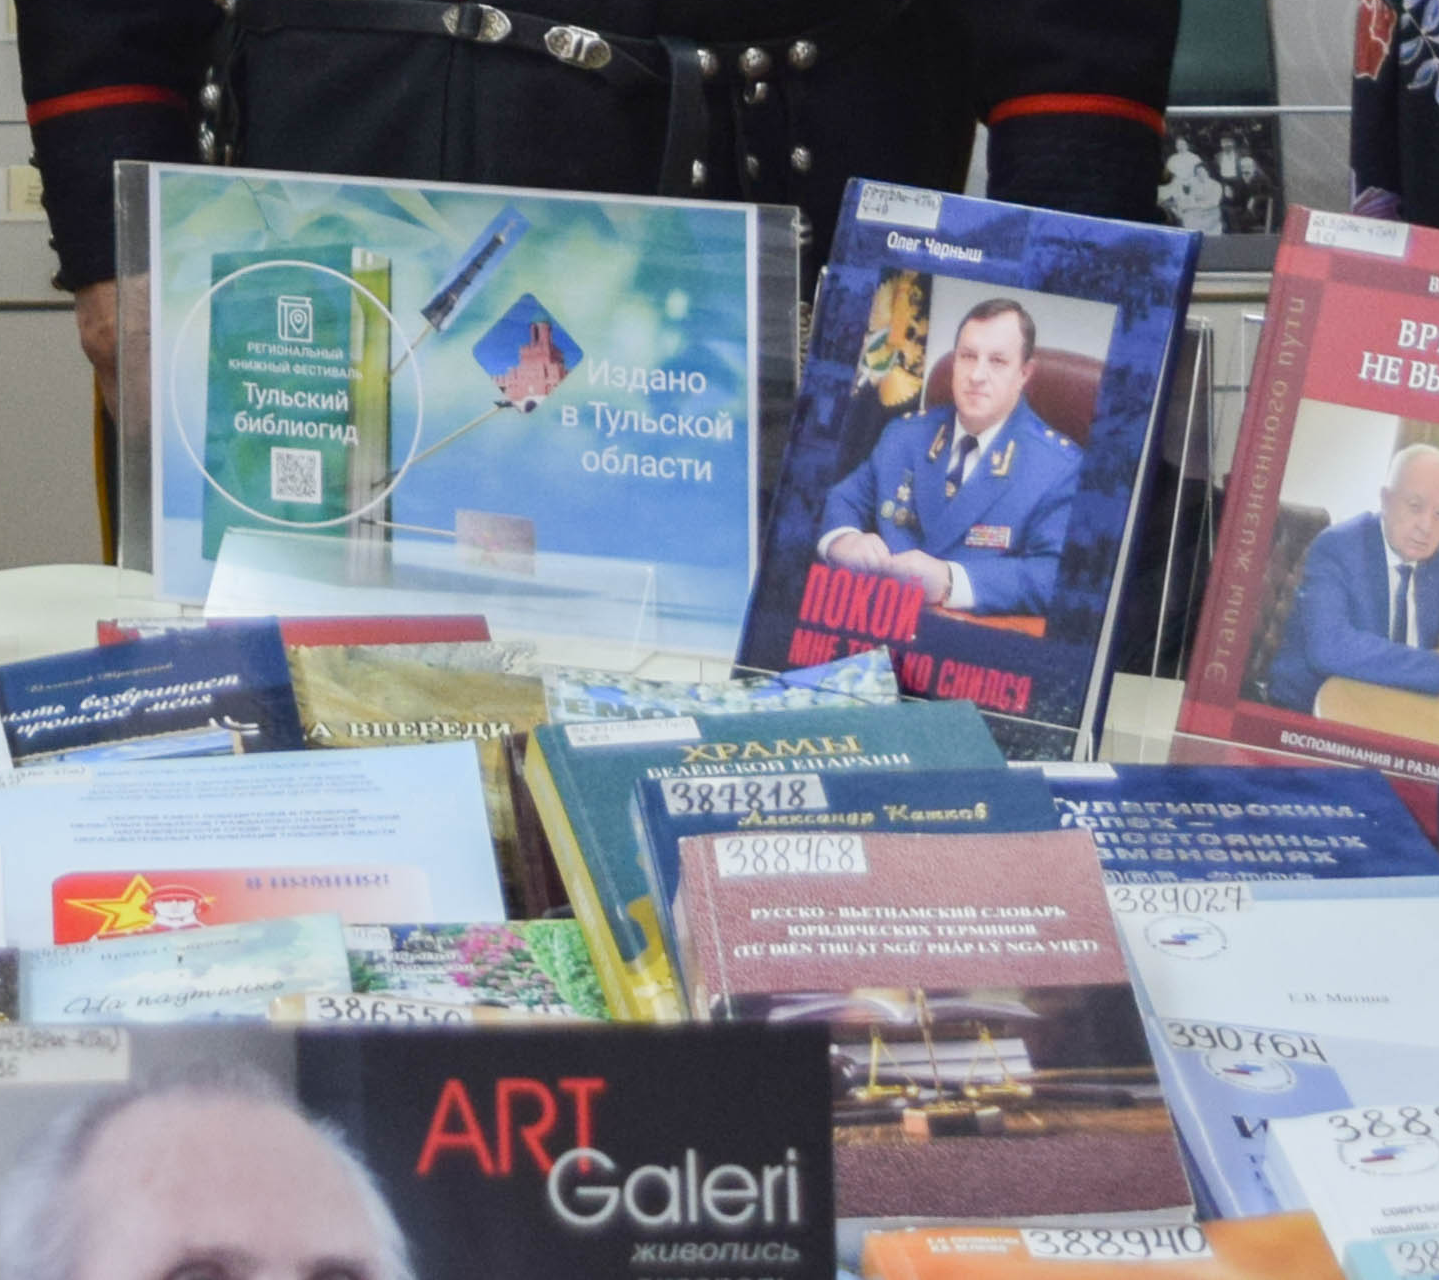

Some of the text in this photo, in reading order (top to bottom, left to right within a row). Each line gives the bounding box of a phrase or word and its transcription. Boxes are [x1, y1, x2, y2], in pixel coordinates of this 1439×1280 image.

[887, 230, 983, 264] Олег Черныш
[228, 358, 291, 374] КНИЖНЫЙ
[247, 340, 345, 361] РЕГИОНАЛЬНЫЙ
[1358, 351, 1402, 383] НЕ
[587, 358, 707, 396] Издано
[241, 381, 350, 413] Тульский
[233, 411, 360, 445] библиогид
[561, 399, 735, 440] в Тульской
[581, 447, 714, 482] области
[798, 561, 925, 643] ПОКОЙ
[936, 658, 1033, 713] СНИЛСЯ
[680, 734, 865, 764] ХРАМЫ
[1279, 729, 1392, 769] ВОСПОМИНАНИЯ
[669, 778, 809, 815] 387818
[725, 834, 856, 875] 388968
[1111, 885, 1246, 914] 389027
[1165, 1020, 1328, 1065] 390764
[416, 1076, 608, 1177] ART
[547, 1147, 803, 1228] Galeri
[631, 1239, 801, 1265] живопись
[1028, 1226, 1209, 1260] 388940
